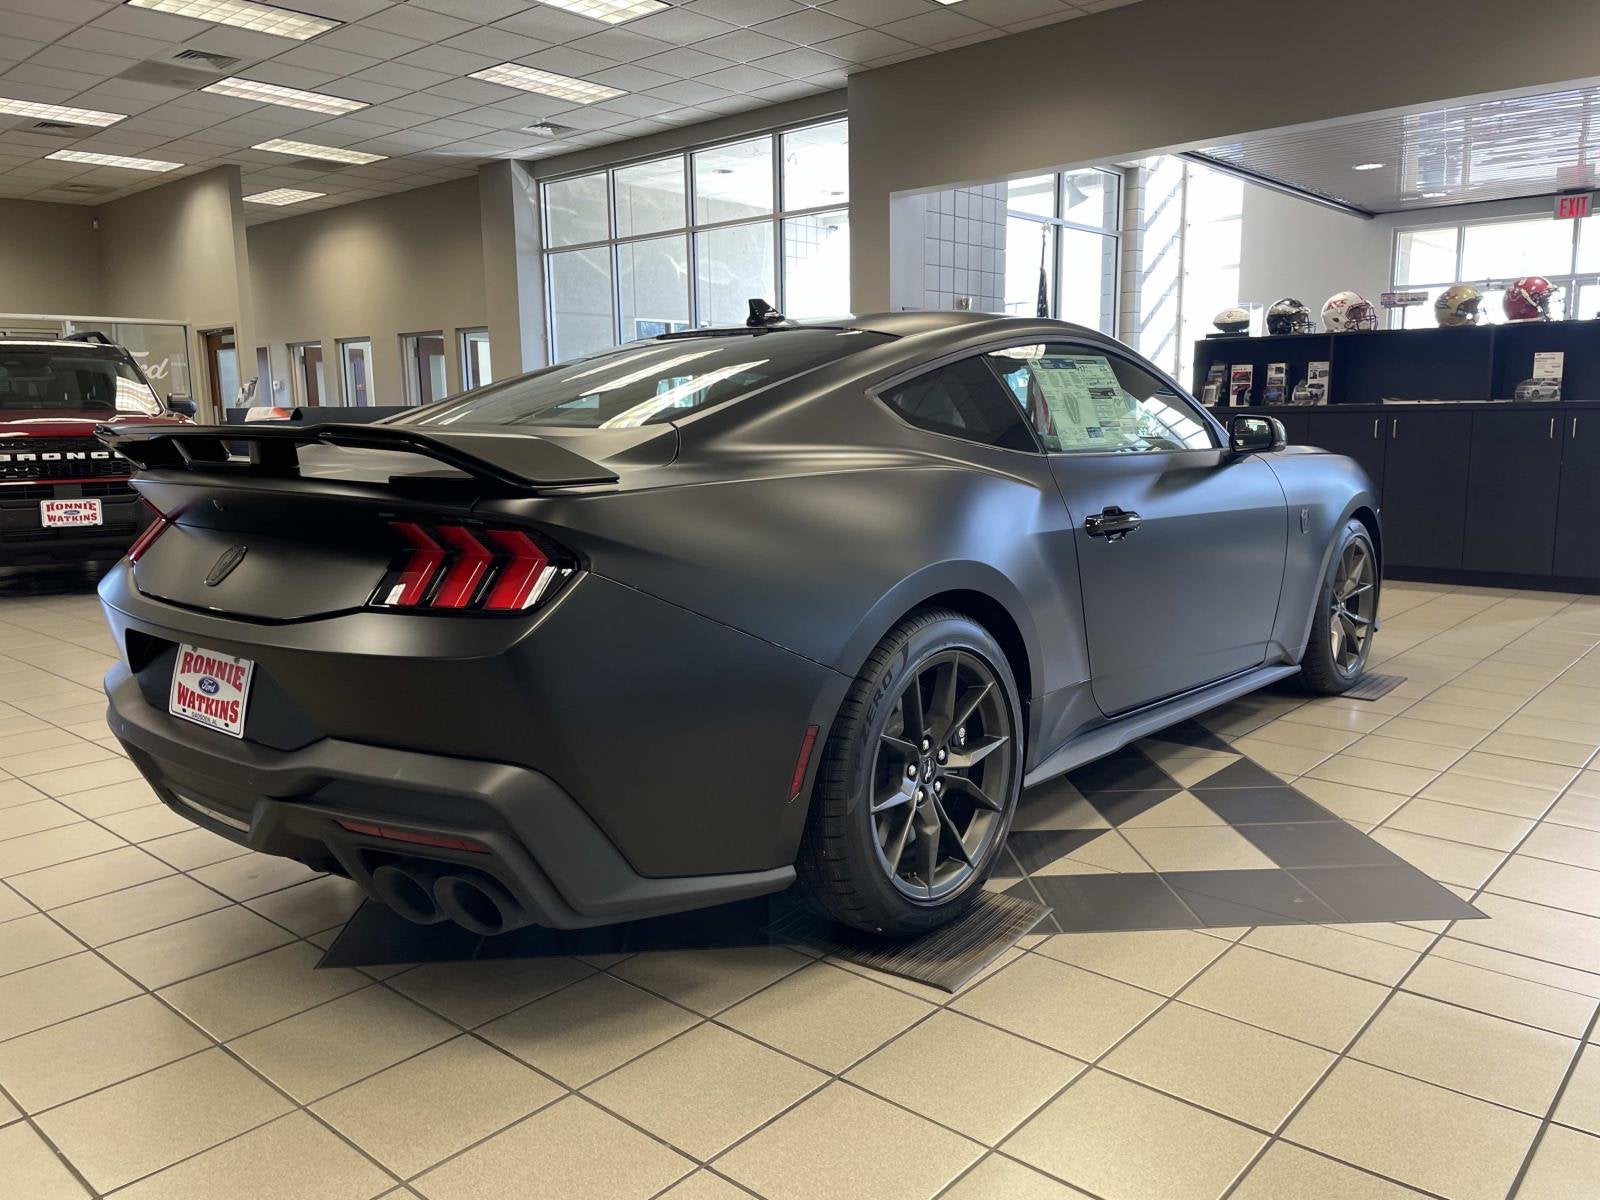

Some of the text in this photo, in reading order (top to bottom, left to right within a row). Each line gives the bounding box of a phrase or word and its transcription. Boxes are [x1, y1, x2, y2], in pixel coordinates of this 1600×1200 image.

[1559, 196, 1588, 218] EXIT
[46, 503, 97, 512] RONNIE
[47, 513, 97, 522] WATKINS
[181, 652, 246, 692] RONNIE
[200, 678, 217, 692] Ford
[177, 682, 240, 724] WATKINS
[862, 669, 892, 744] ZERO
